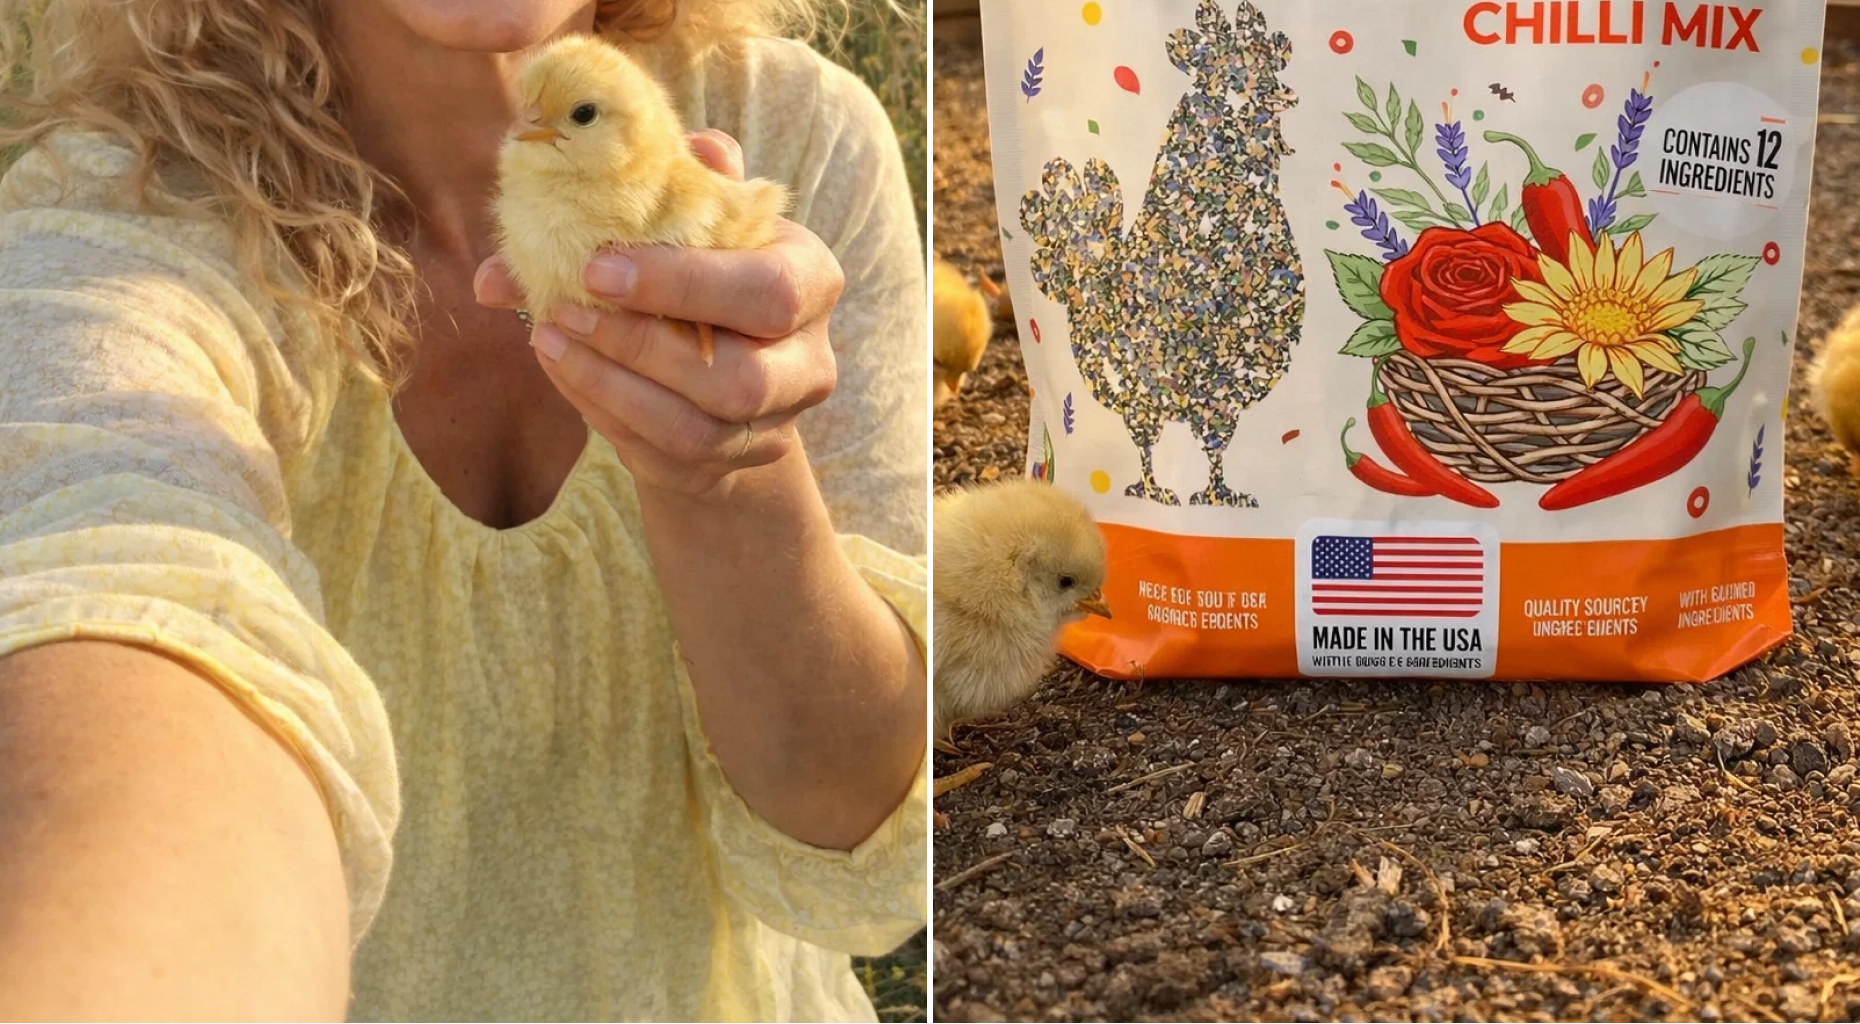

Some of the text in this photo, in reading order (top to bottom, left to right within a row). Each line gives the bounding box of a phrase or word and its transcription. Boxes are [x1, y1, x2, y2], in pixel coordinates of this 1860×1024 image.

[1463, 0, 1763, 52] CHILLI MIX
[1663, 127, 1783, 170] CONTAINS 12
[1659, 157, 1775, 199] INGREDIENTS
[1524, 598, 1580, 618] QUALITY
[1312, 626, 1482, 651] MADE IN THE USA
